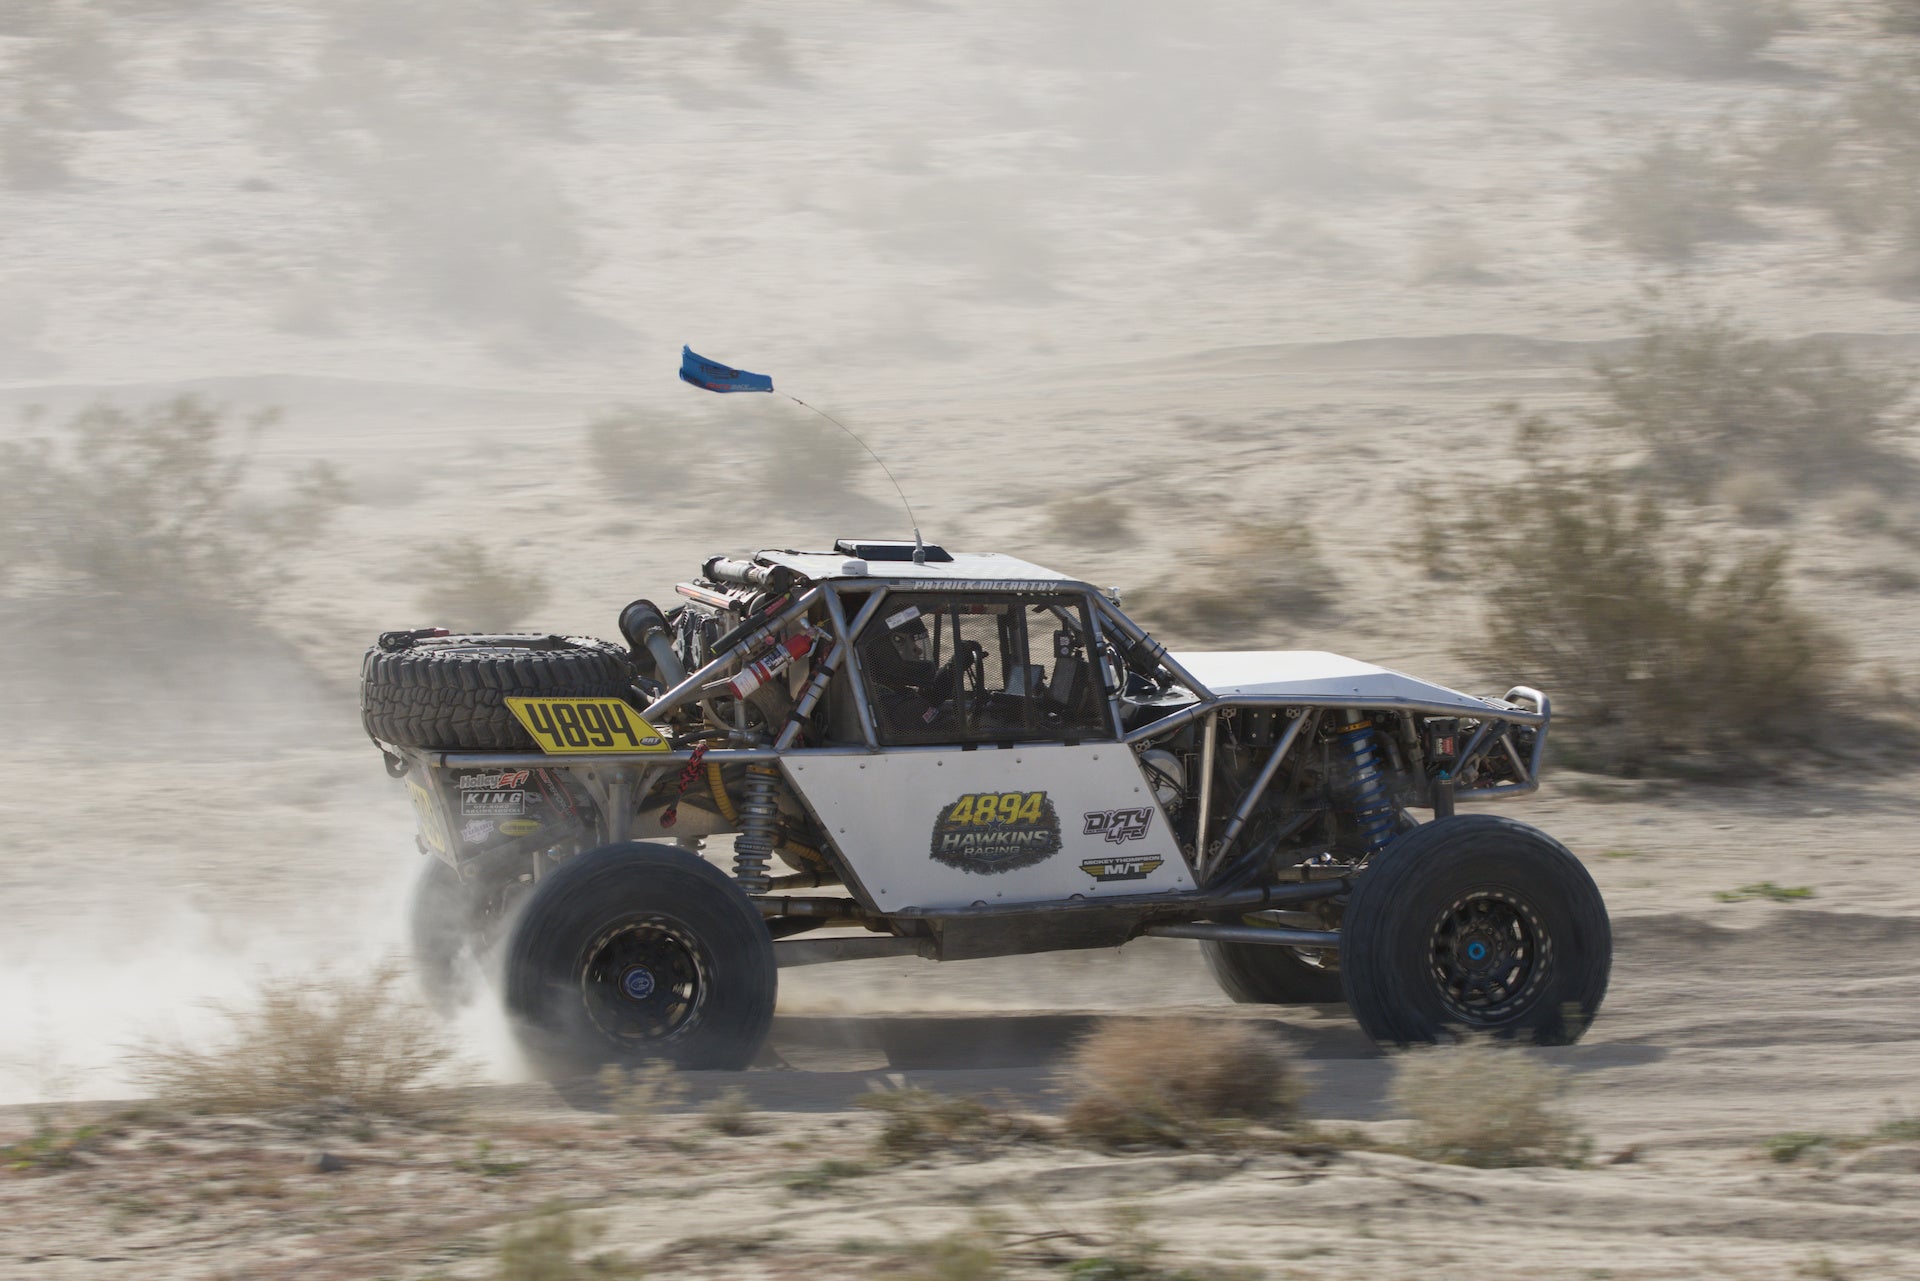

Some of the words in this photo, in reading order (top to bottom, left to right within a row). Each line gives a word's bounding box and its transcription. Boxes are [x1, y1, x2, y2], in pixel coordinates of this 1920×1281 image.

[912, 581, 976, 590] PATRICK
[525, 704, 639, 747] 4894
[460, 774, 501, 789] Holley
[497, 770, 530, 788] EFI
[466, 793, 522, 803] KING
[947, 791, 1047, 826] 4894
[1086, 808, 1152, 830] DIRTY
[942, 830, 1050, 850] HAWKINS
[1107, 826, 1146, 842] LIFE
[964, 845, 1021, 856] RACING
[1084, 858, 1114, 866] MICKEY
[1115, 856, 1160, 864] THOMPSON
[1104, 862, 1144, 875] M/T
